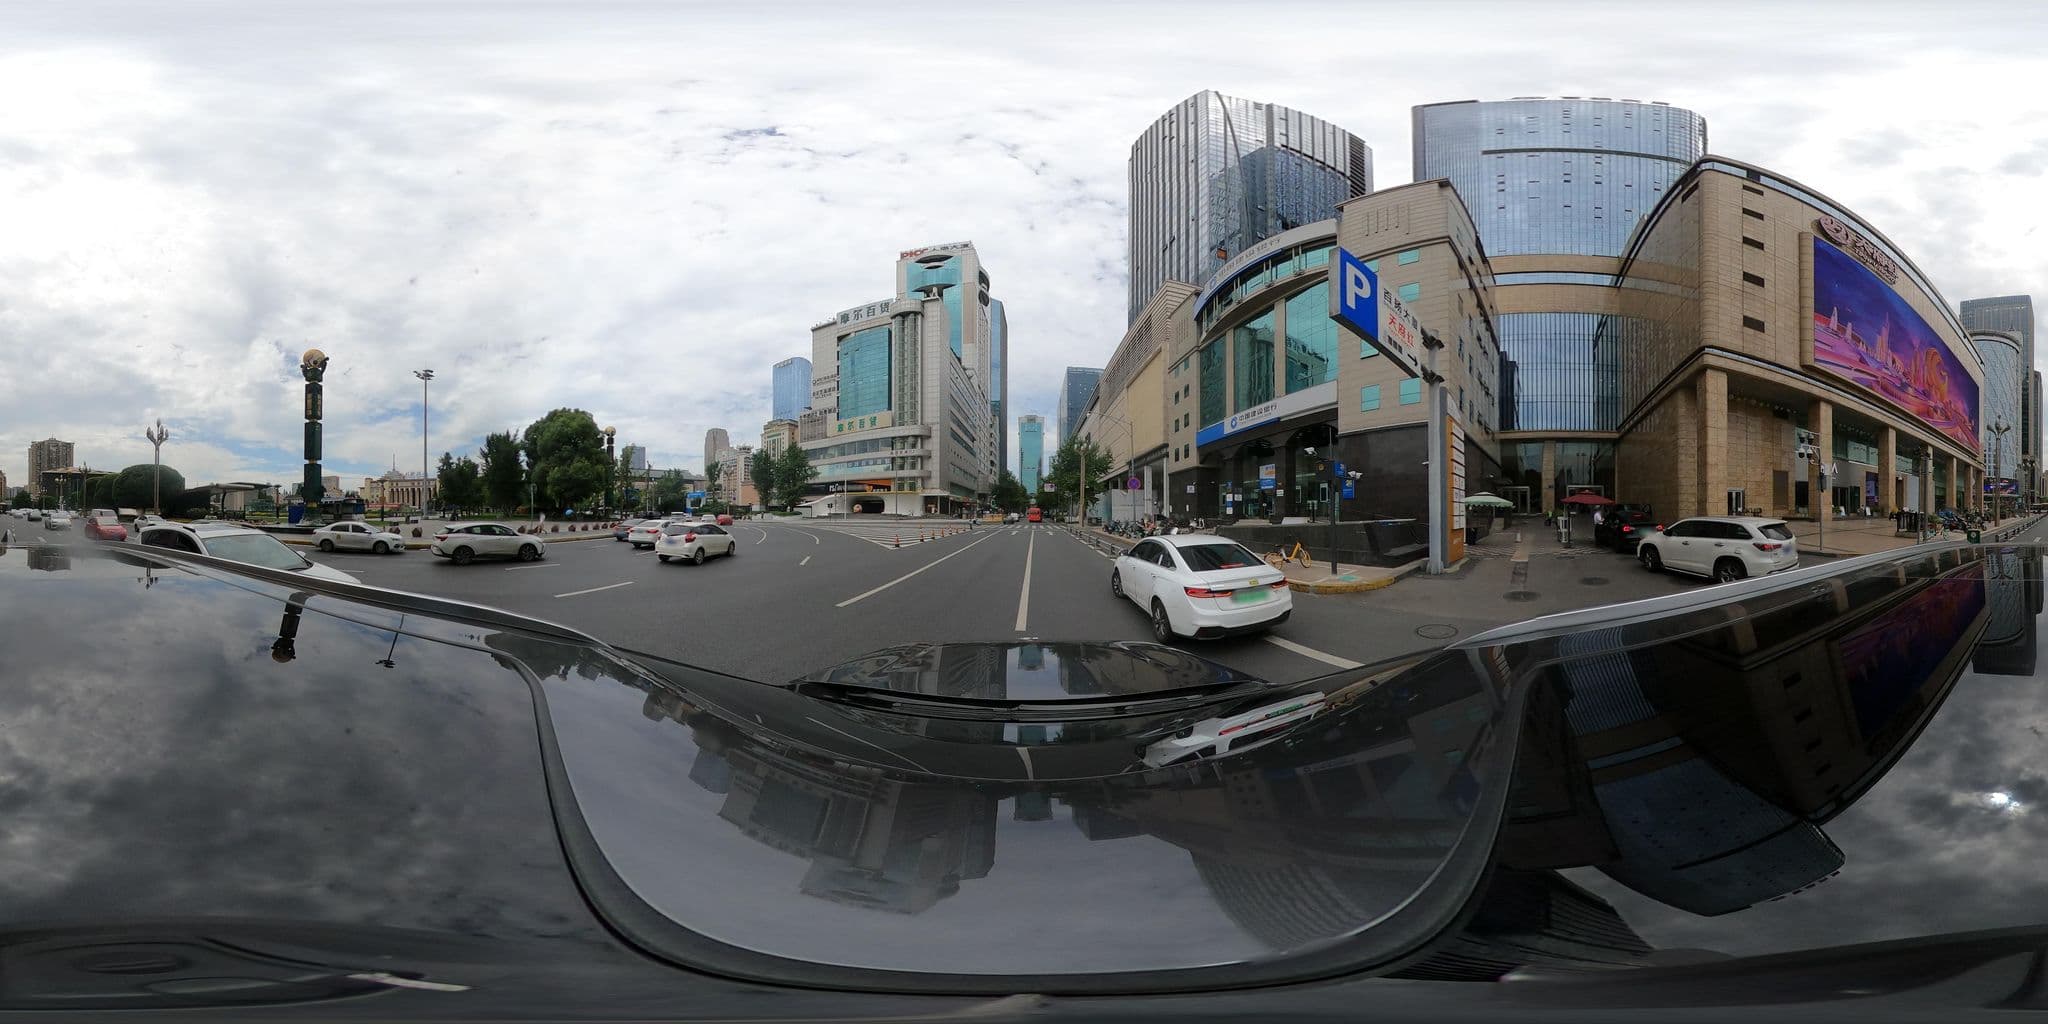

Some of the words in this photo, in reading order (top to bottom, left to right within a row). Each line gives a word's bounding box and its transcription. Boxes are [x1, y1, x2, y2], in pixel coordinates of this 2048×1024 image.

[1345, 261, 1371, 310] P
[840, 301, 890, 324] 摩尔百货
